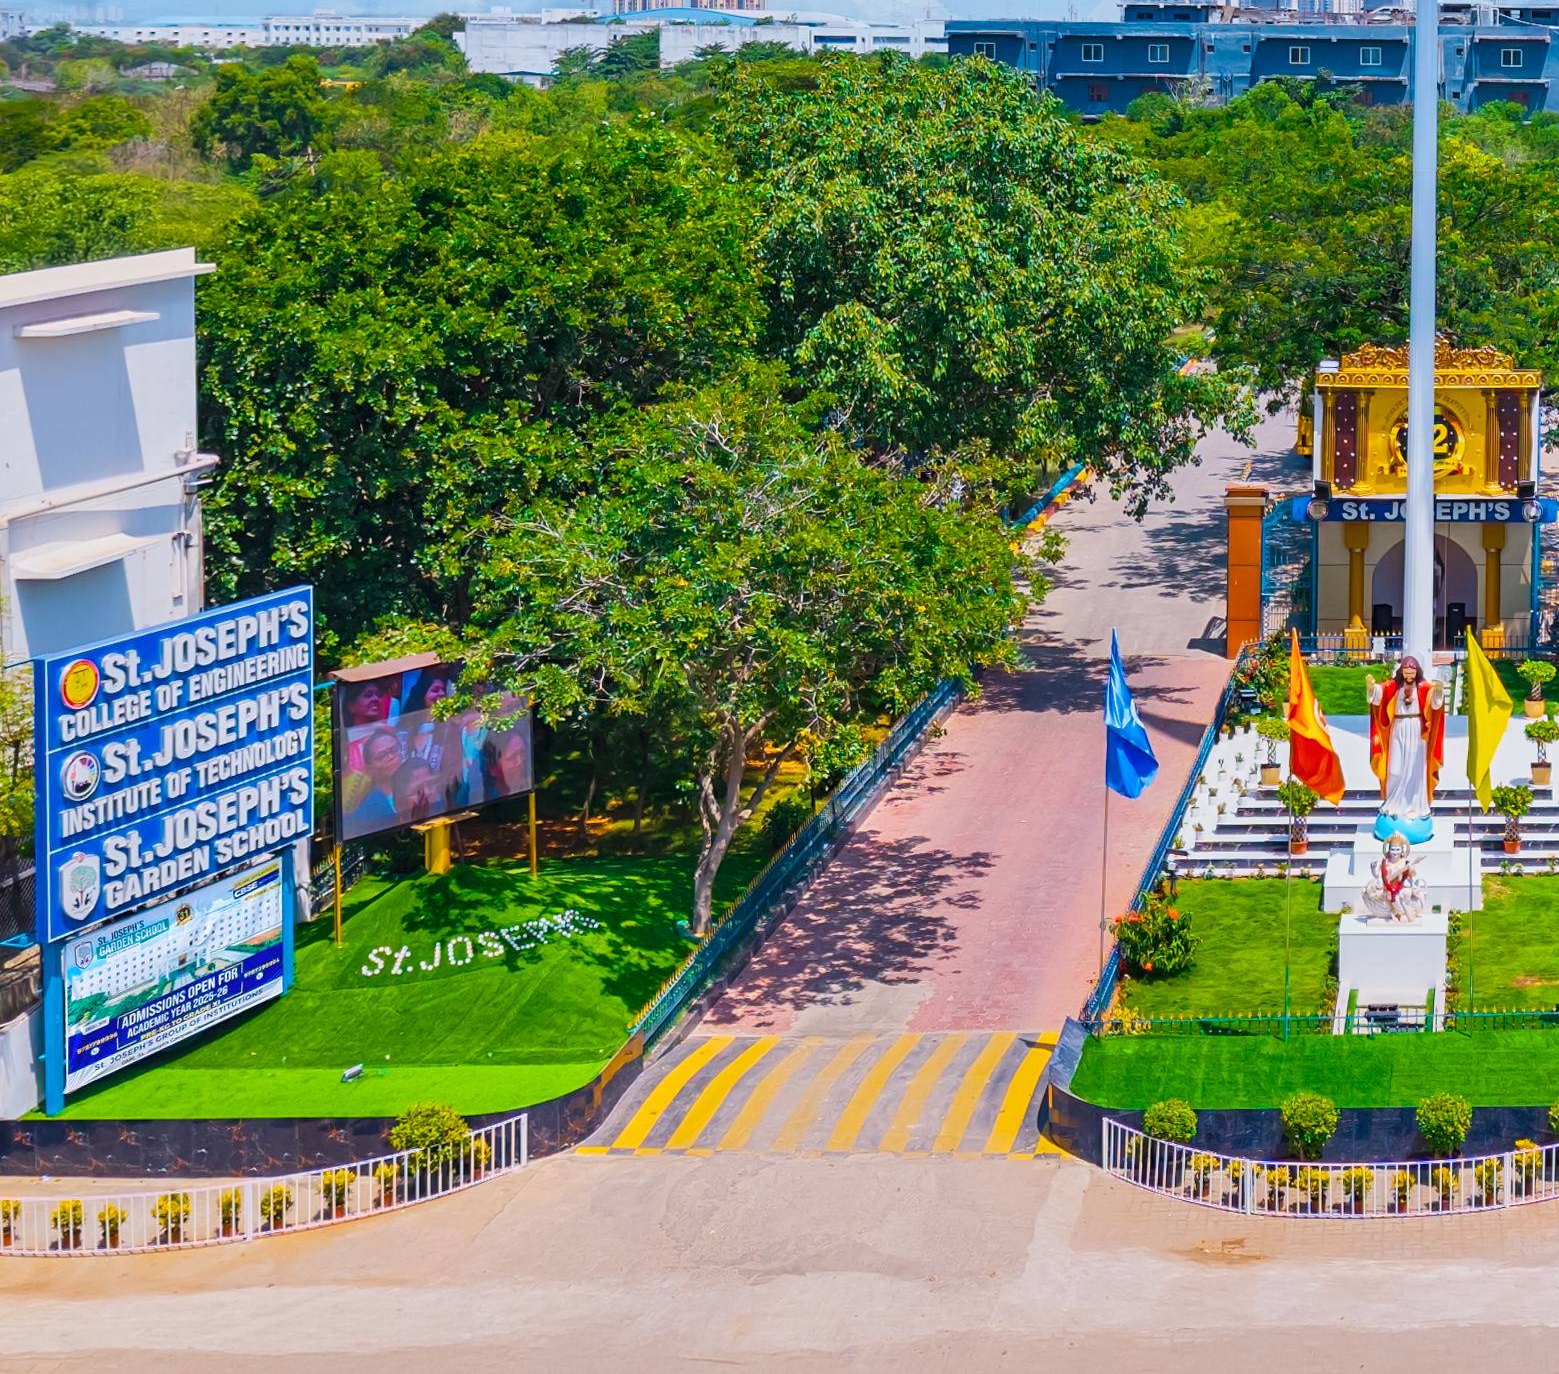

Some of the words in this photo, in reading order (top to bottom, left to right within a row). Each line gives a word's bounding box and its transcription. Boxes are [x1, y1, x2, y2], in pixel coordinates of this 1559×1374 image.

[1342, 502, 1376, 520] St.
[1384, 502, 1510, 521] JEPH'S
[58, 690, 151, 743] COLLEGE
[155, 680, 183, 712] OF
[188, 643, 309, 702] ENGINEERING
[59, 778, 162, 839] INSTITUTE
[165, 768, 192, 799] OF
[193, 726, 309, 788] TECHNOLOGY
[102, 845, 211, 910] GARDEN
[214, 808, 310, 864] SCHOOL
[234, 881, 259, 898] CBSE
[99, 935, 134, 957] GARDEN
[135, 922, 168, 942] SCHOOL
[111, 919, 145, 941] JOSEPH'S
[110, 1038, 154, 1064] JOSEPH'S
[155, 1023, 188, 1043] GROUP
[189, 1016, 202, 1028] OF
[203, 987, 264, 1021] INSTITUTIONS
[121, 990, 186, 1030] ADMISSIONS
[188, 976, 216, 999] OPEN
[218, 967, 239, 986] FOR
[127, 1011, 170, 1039] ACADEMIC
[170, 1000, 192, 1019] YEAR
[192, 985, 229, 1009] 2025-26
[171, 1017, 183, 1027] TO
[183, 1003, 211, 1022] GRADE
